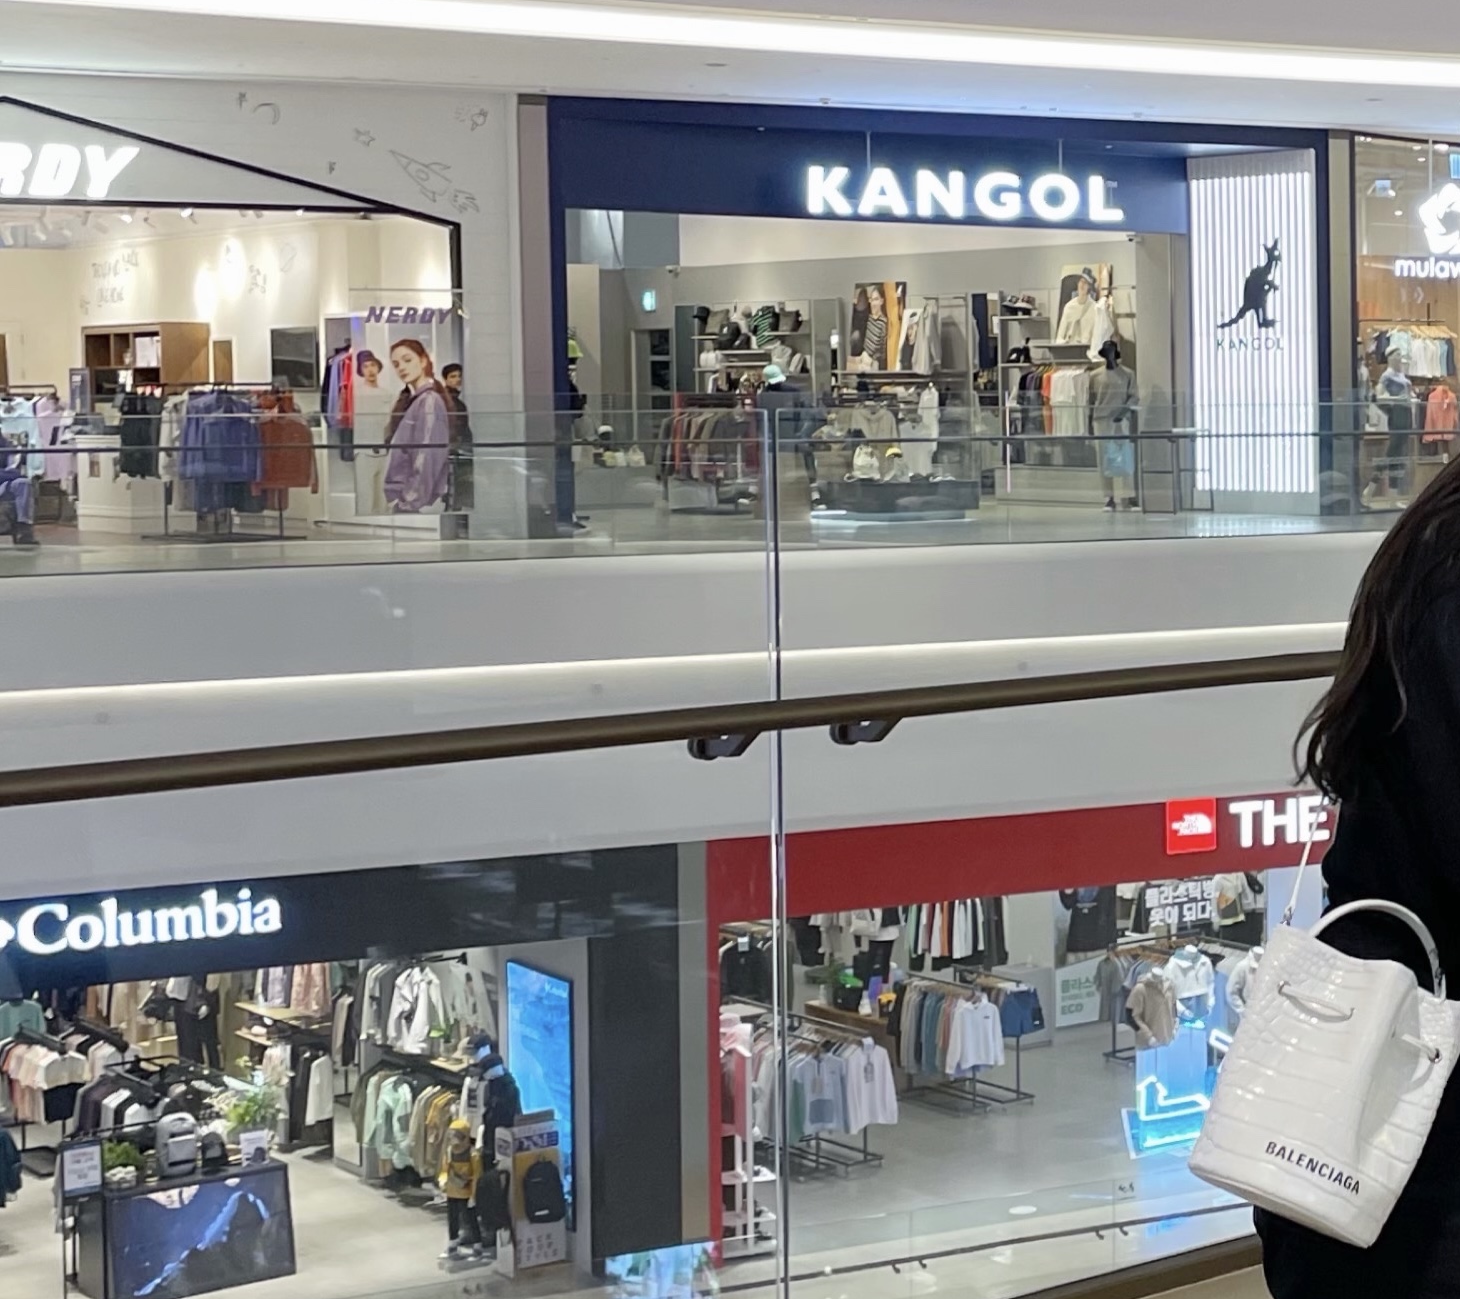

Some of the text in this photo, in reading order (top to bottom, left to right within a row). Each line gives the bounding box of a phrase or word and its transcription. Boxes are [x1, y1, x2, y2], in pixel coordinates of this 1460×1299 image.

[806, 164, 1125, 221] KANGOL
[365, 306, 452, 324] NERDY
[1216, 338, 1284, 351] KANGOL
[1229, 795, 1331, 848] THE
[17, 887, 282, 955] Columbia
[1061, 1003, 1084, 1015] ECO
[1265, 1141, 1360, 1195] BALENCIAGA
